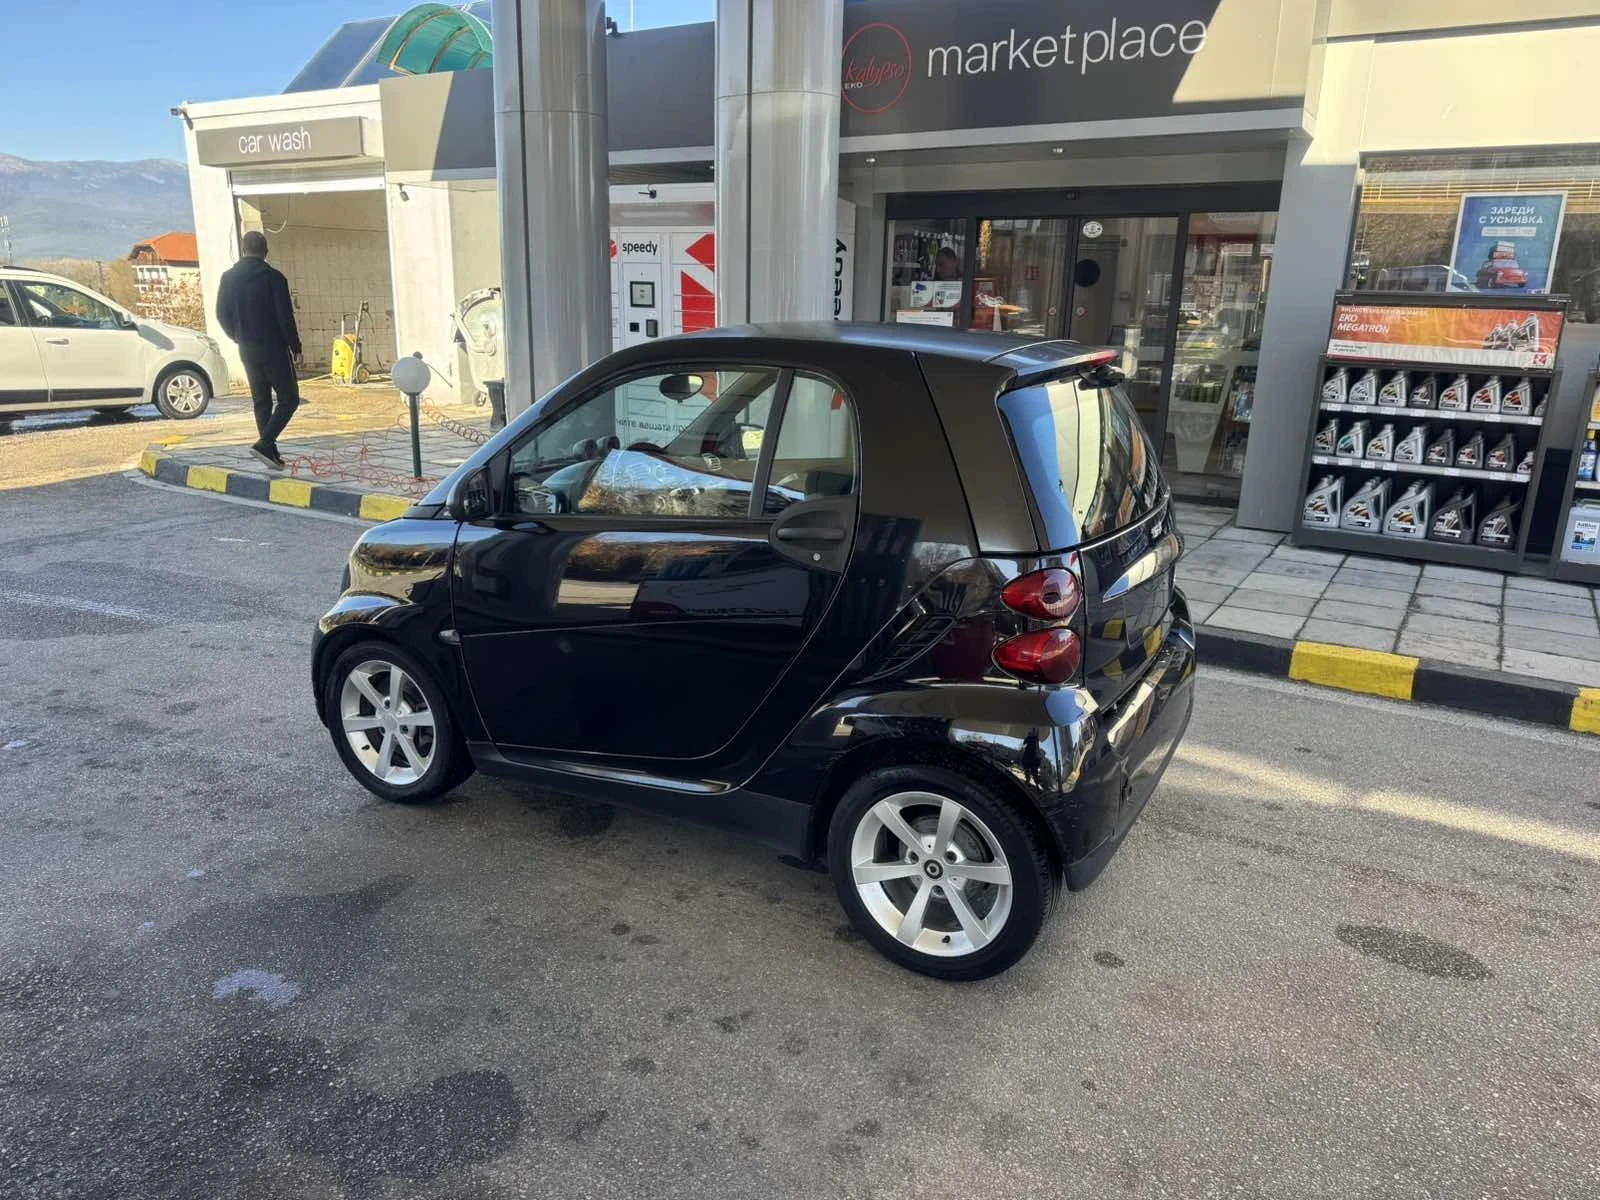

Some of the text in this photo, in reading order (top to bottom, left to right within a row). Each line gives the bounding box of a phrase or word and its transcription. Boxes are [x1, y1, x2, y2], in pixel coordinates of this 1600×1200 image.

[928, 17, 1208, 76] marketplace
[844, 81, 864, 89] EKO
[238, 126, 312, 153] car wash
[1490, 206, 1536, 215] ЗАРЕДИ
[1489, 215, 1544, 224] УСМИВКА
[622, 240, 658, 256] speedy
[1338, 313, 1359, 323] EKO
[1336, 322, 1391, 334] MEGATRON
